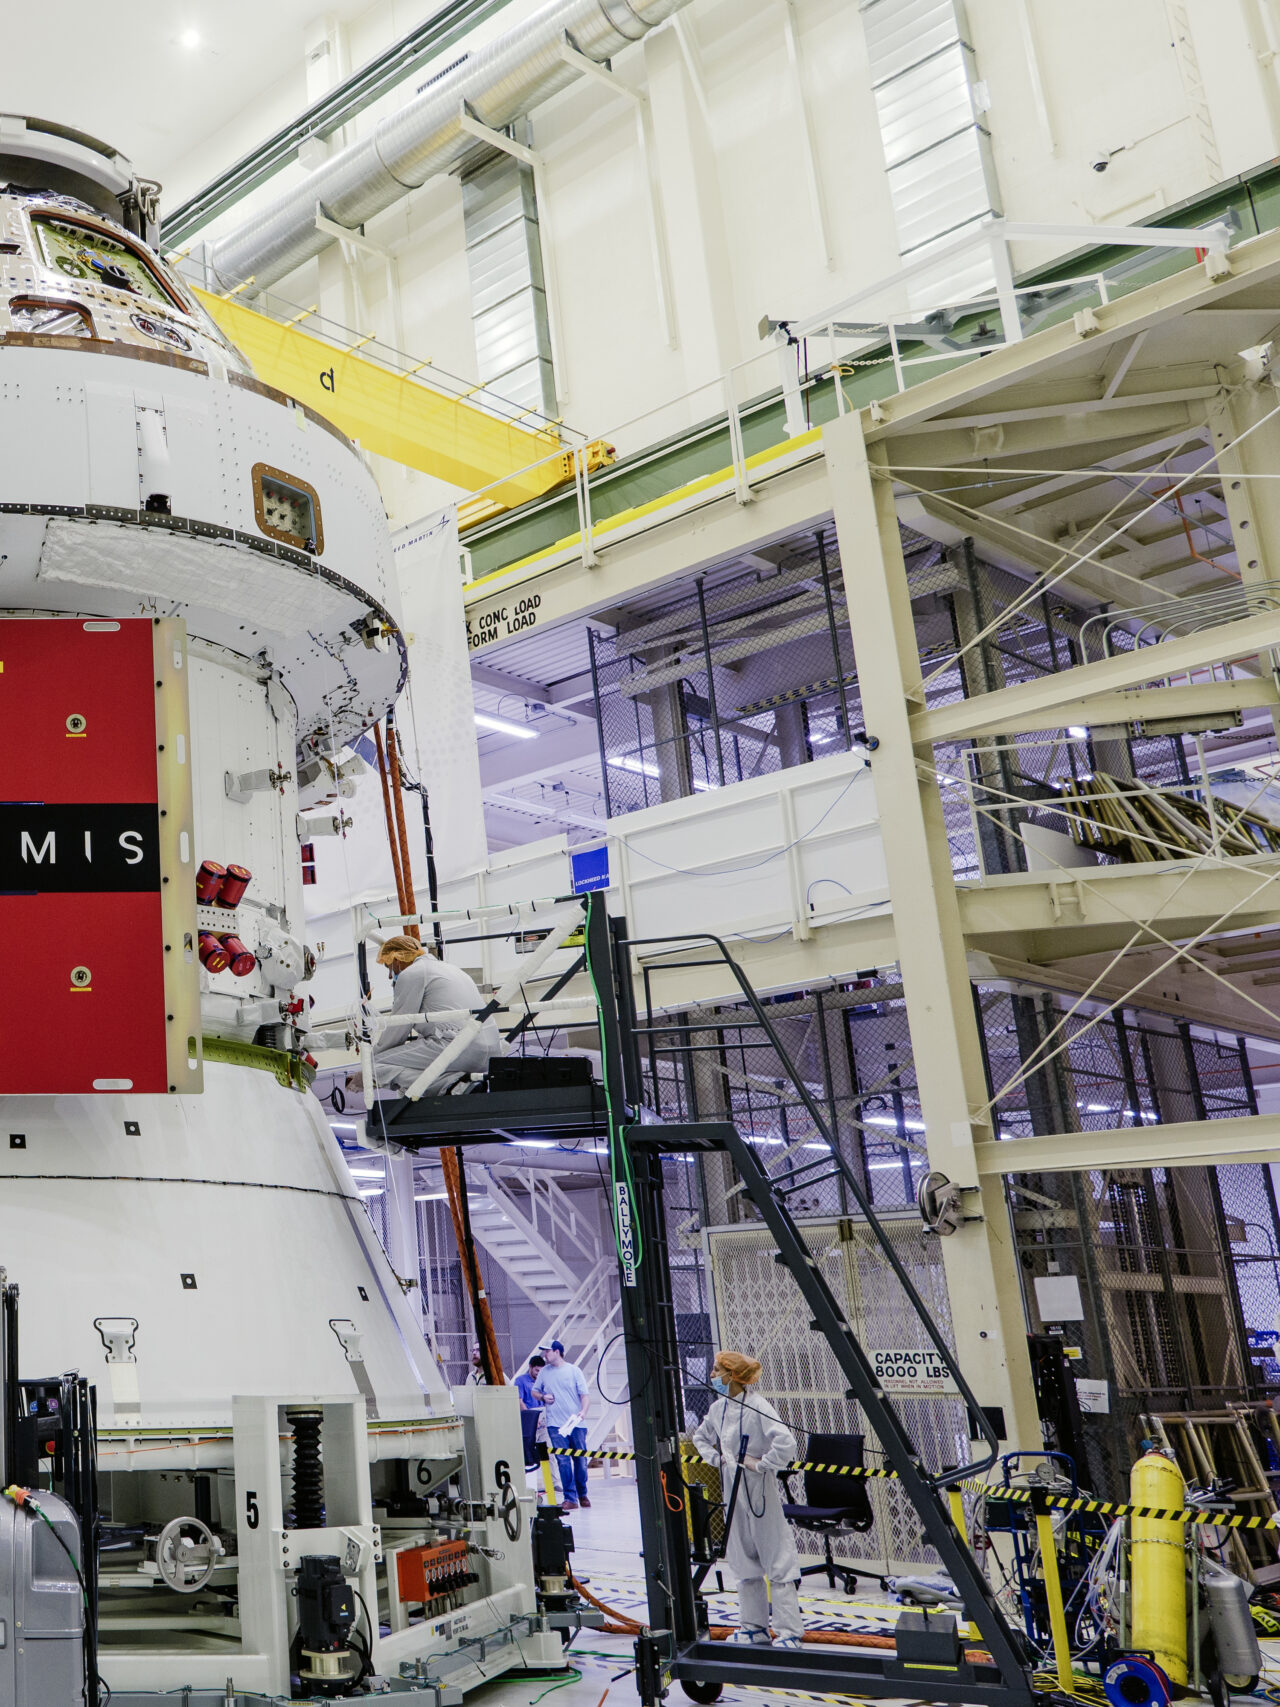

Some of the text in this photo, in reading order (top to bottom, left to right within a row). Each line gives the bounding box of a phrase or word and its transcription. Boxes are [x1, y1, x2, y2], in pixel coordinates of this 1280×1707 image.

[478, 607, 508, 630] CONC
[514, 594, 541, 616] LOAD
[507, 612, 536, 634] LOAD
[576, 876, 601, 886] LOCKHEED
[619, 1186, 633, 1282] BALLYMORE
[875, 1352, 946, 1364] CAPACITY
[875, 1366, 950, 1378] 8000 LBS
[417, 1460, 432, 1485] 6
[495, 1460, 511, 1489] 6
[247, 1490, 260, 1530] 5
